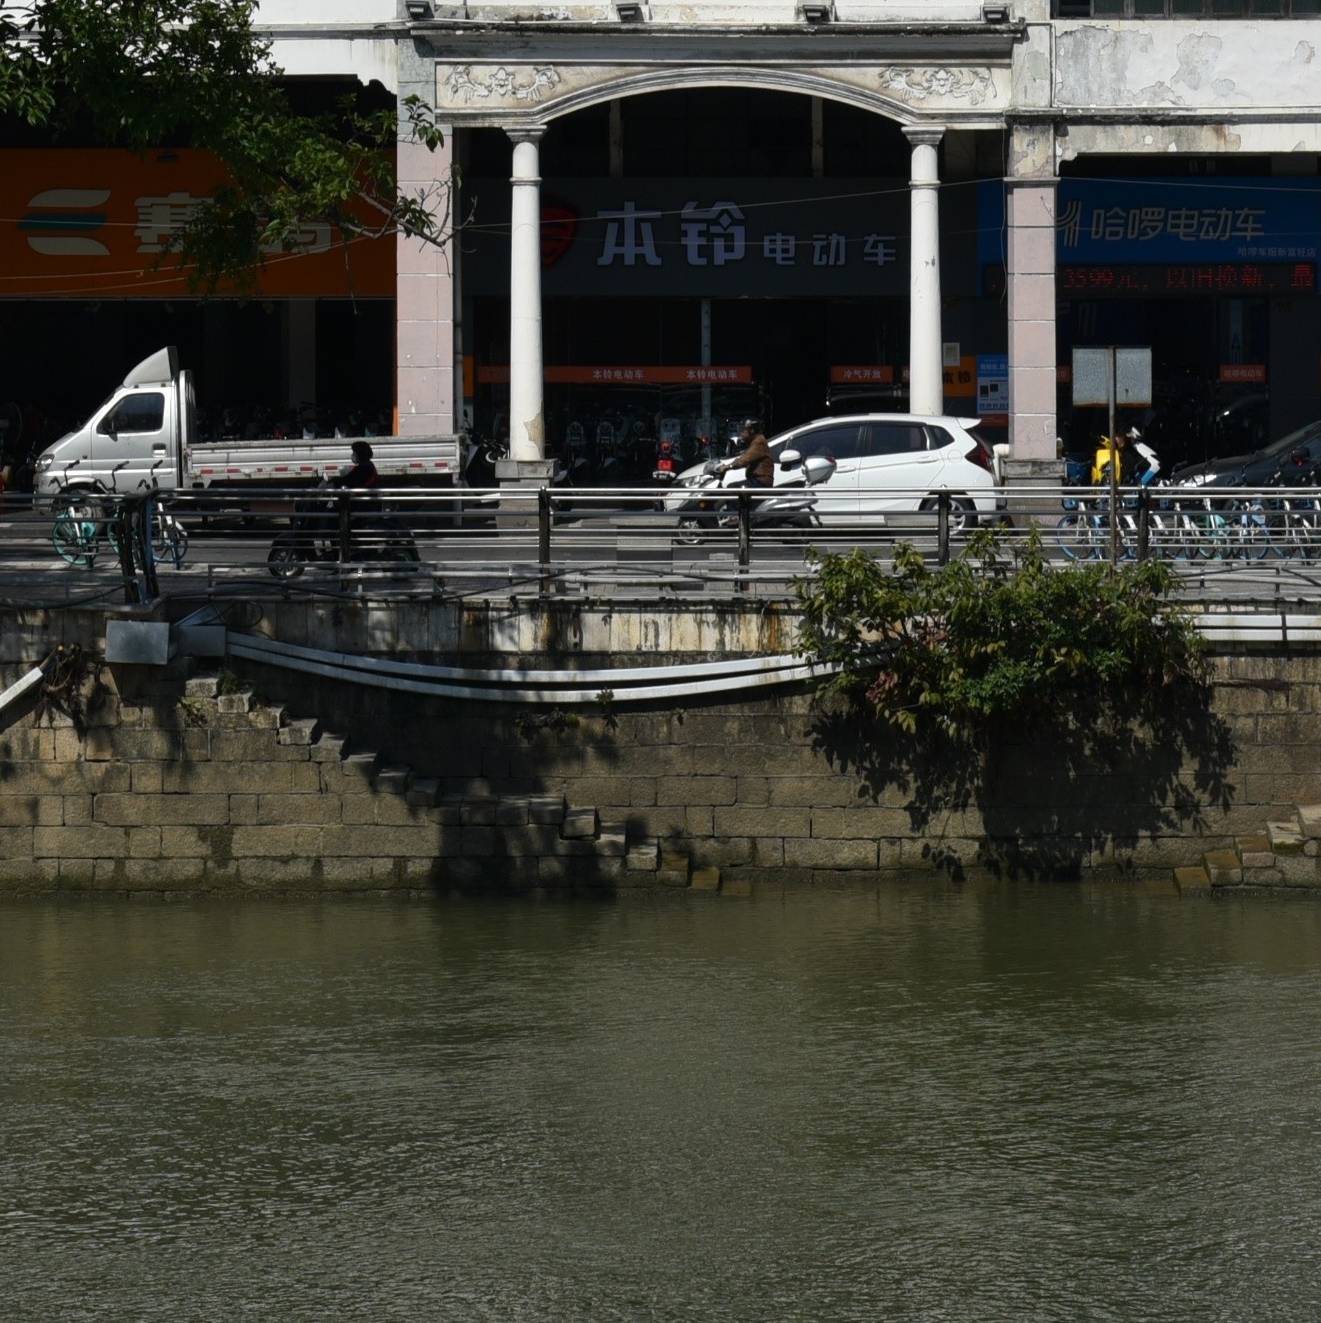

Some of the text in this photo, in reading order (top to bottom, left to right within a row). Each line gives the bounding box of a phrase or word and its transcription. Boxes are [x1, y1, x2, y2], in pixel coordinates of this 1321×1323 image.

[1089, 207, 1267, 242] 哈啰电动车
[592, 368, 645, 380] 本铃电动车
[685, 368, 739, 380] 本铃电动车
[843, 369, 882, 380] 冷气开放
